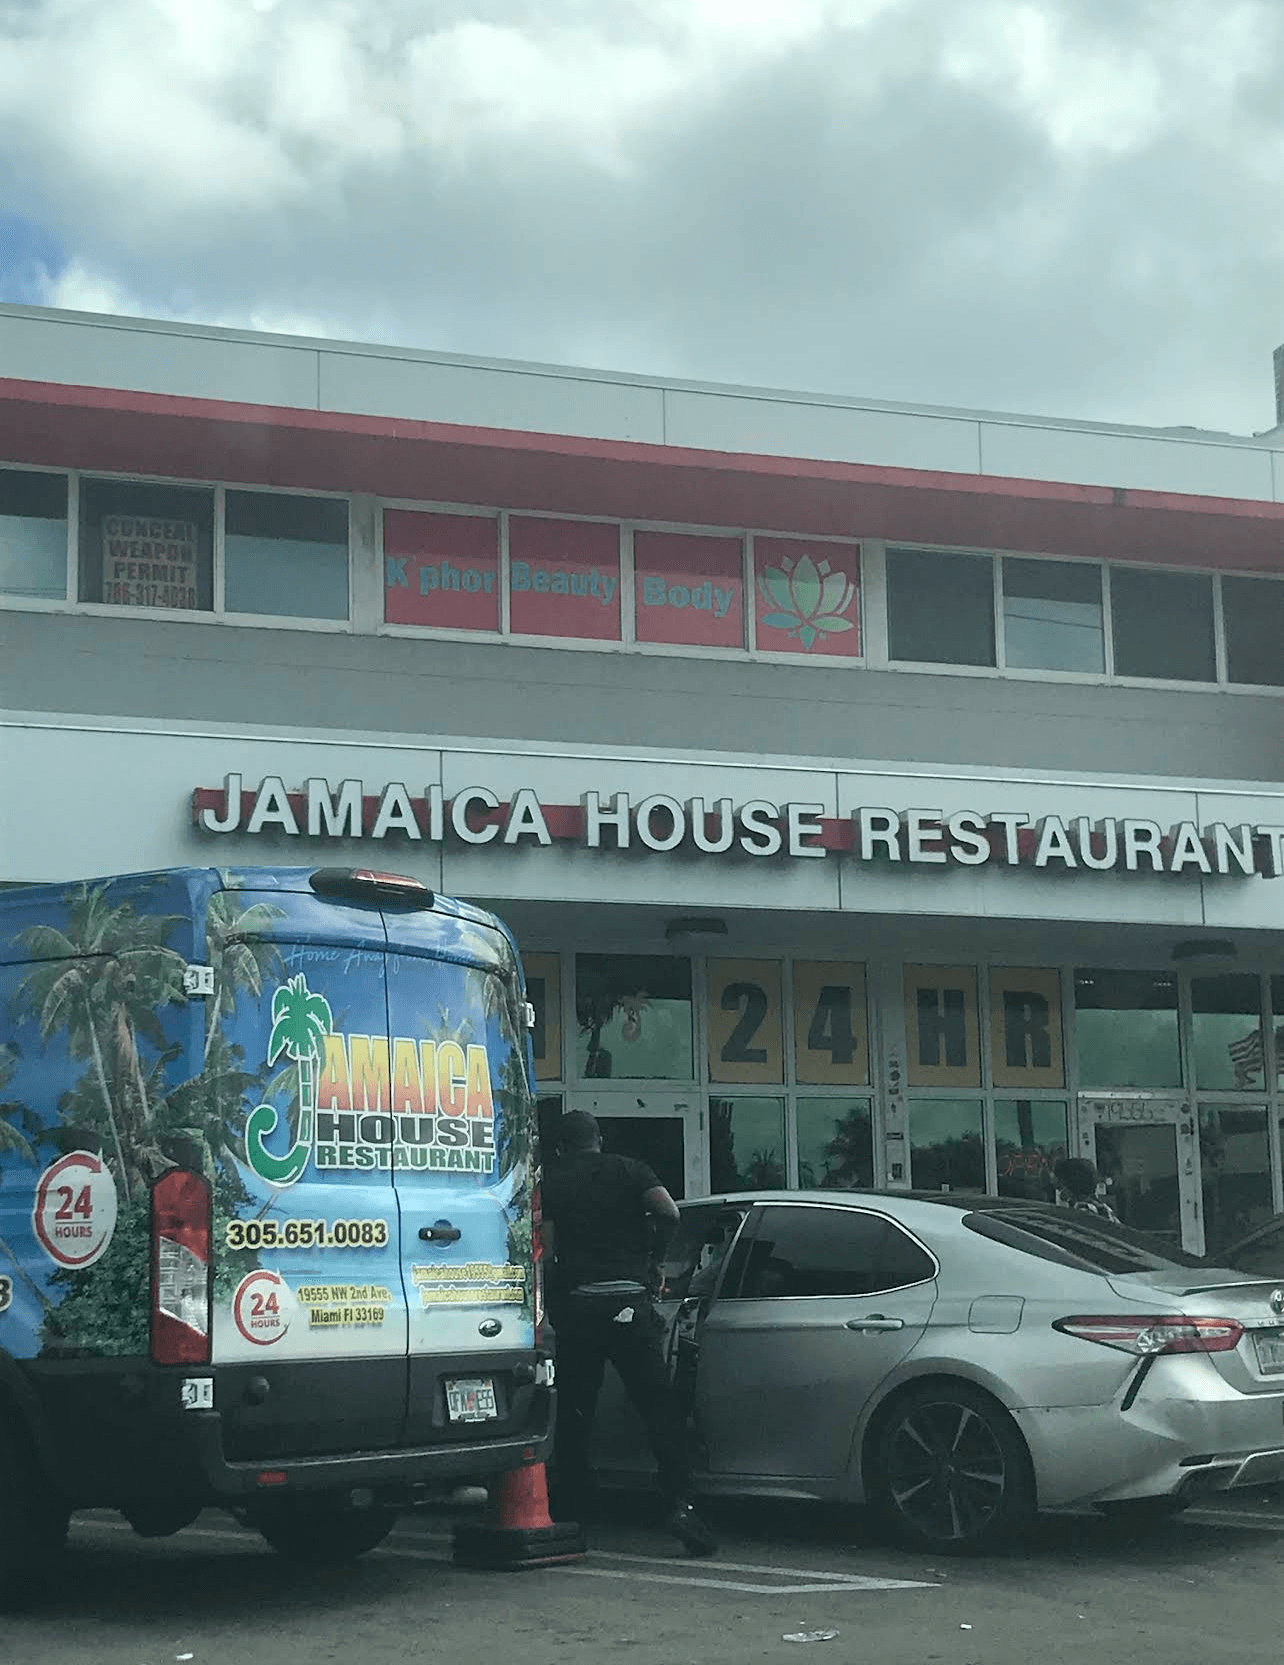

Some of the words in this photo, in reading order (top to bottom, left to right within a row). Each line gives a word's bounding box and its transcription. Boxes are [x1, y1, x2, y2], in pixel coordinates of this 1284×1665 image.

[114, 562, 189, 583] PERMIT
[386, 555, 410, 588] K
[419, 560, 497, 596] phor
[511, 562, 617, 607] Beauty
[642, 576, 734, 618] Body
[202, 773, 553, 846] JAMAICA
[582, 790, 827, 860] HOUSE
[853, 806, 1284, 878] RESTAURANT
[317, 1113, 495, 1149] HOUSE
[317, 1145, 496, 1173] RESTAURANT
[55, 1185, 94, 1220] 24
[55, 1226, 94, 1238] HOURS
[227, 1222, 387, 1246] 305.651.0083
[250, 1292, 280, 1315] 24
[298, 1287, 329, 1301] 19555
[331, 1286, 348, 1300] NW
[350, 1286, 368, 1299] 2nd
[250, 1318, 280, 1328] HOURS
[311, 1309, 341, 1323] Miami
[355, 1307, 384, 1321] 33169
